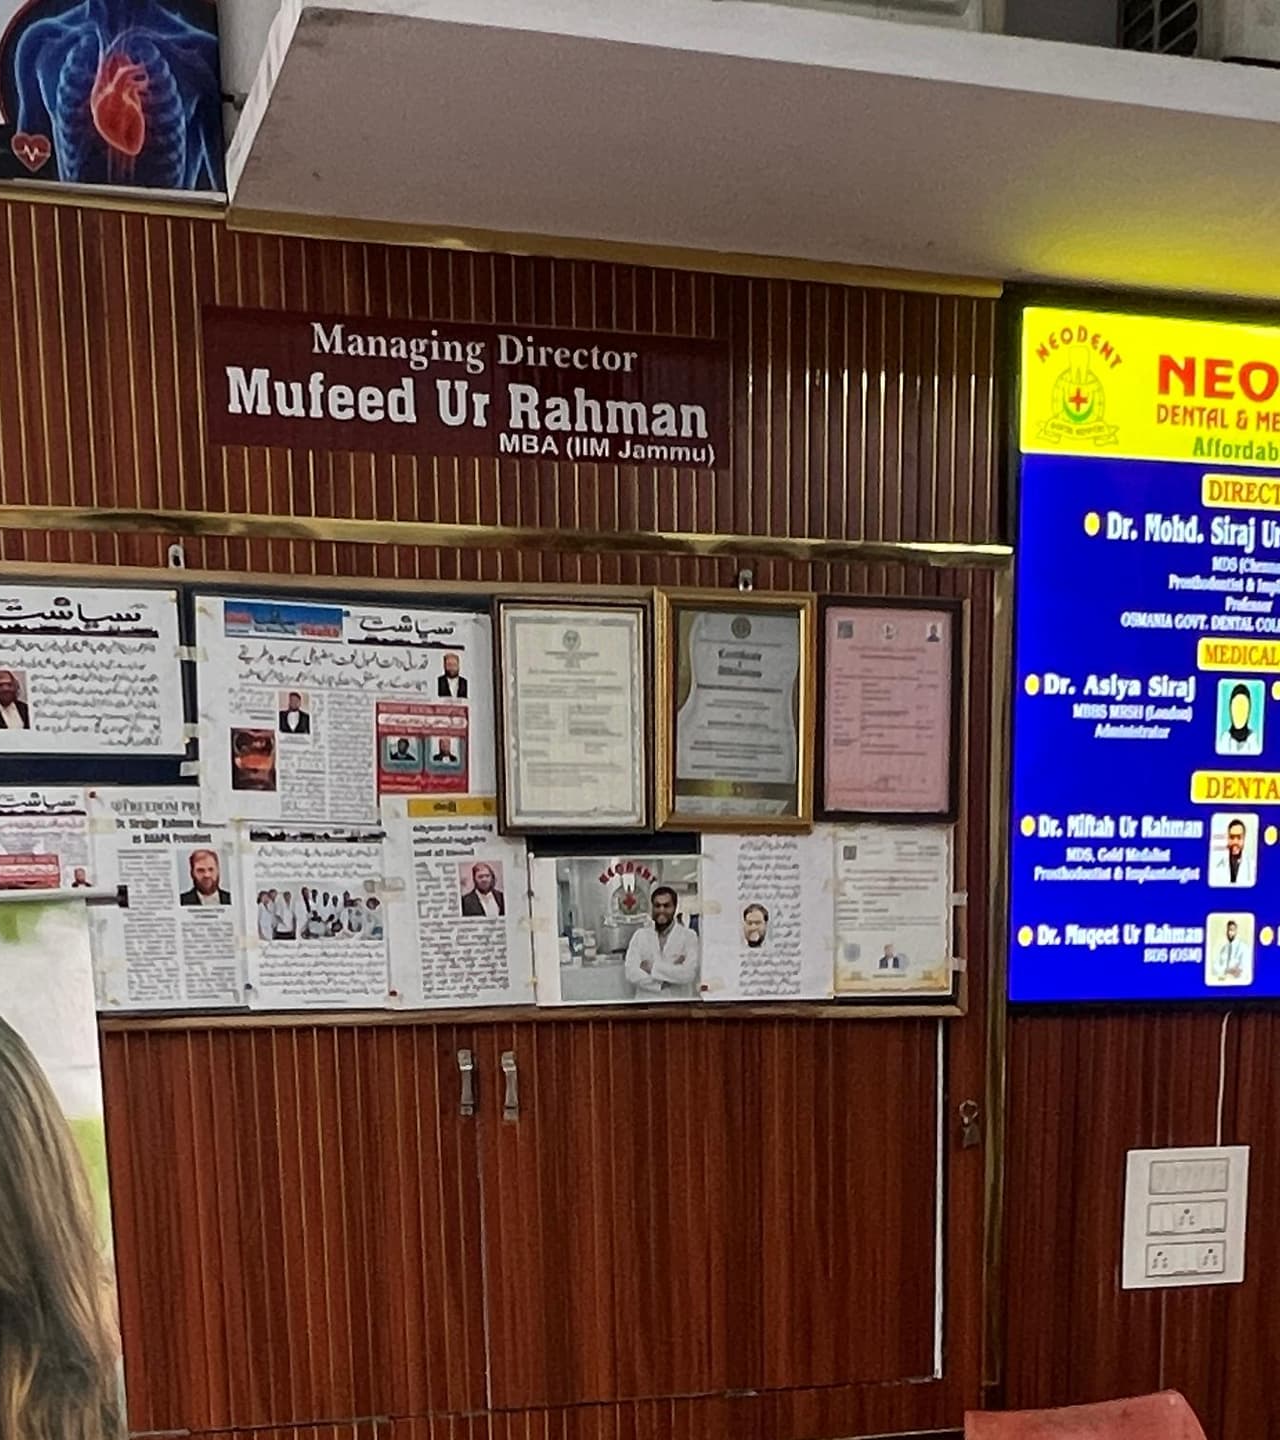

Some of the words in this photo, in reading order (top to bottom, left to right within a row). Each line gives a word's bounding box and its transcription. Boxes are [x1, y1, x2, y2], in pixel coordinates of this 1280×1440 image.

[310, 321, 485, 374] Managing
[498, 333, 638, 372] Director
[1036, 325, 1122, 370] NEODENT
[225, 365, 417, 425] Mufeed
[436, 378, 490, 428] Ur
[507, 382, 709, 439] Rahman
[1156, 404, 1229, 430] DENTAL
[1236, 410, 1247, 430] &
[499, 432, 559, 457] MBA
[566, 434, 611, 460] (IIM
[617, 438, 717, 468] Jammu)
[1106, 511, 1138, 540] Dr.
[1144, 513, 1204, 544] Mohd.
[1210, 515, 1256, 553] Siraj
[1121, 611, 1173, 628] OSMANIA
[1211, 615, 1254, 631] DENTAL
[1203, 643, 1280, 667] MEDICAL
[1043, 673, 1076, 695] Dr.
[1147, 675, 1196, 702] Siraj
[1038, 814, 1063, 838] Dr.
[1119, 816, 1139, 838] Ur
[1141, 816, 1203, 838] Rahman
[1037, 924, 1061, 945] Dr.
[1123, 925, 1141, 944] Ur
[1144, 923, 1204, 945] Rahman
